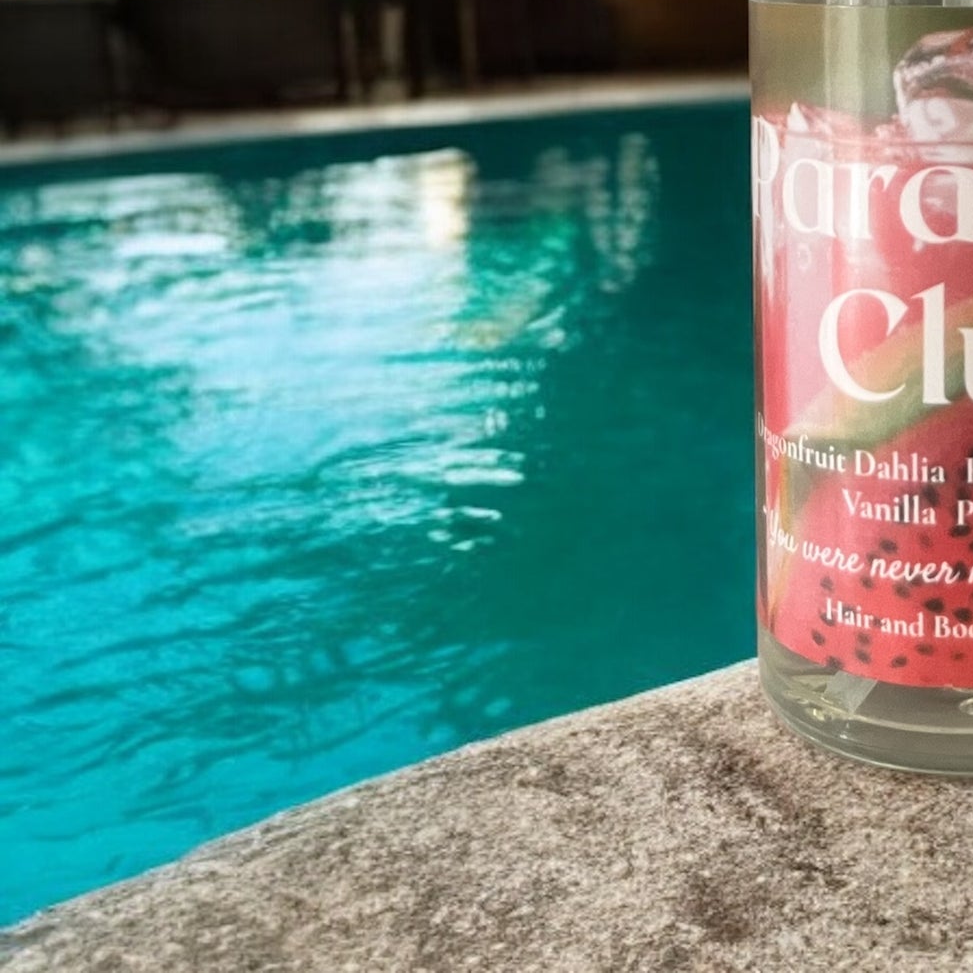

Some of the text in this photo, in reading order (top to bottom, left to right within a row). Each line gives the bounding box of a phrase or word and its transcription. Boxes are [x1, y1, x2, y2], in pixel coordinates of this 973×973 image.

[758, 411, 847, 473] Dragonfruit
[854, 449, 945, 483] Dahlia
[842, 488, 937, 525] Vanilla
[802, 540, 865, 573] were
[870, 557, 961, 585] never
[825, 598, 874, 629] Hair
[880, 611, 924, 638] and
